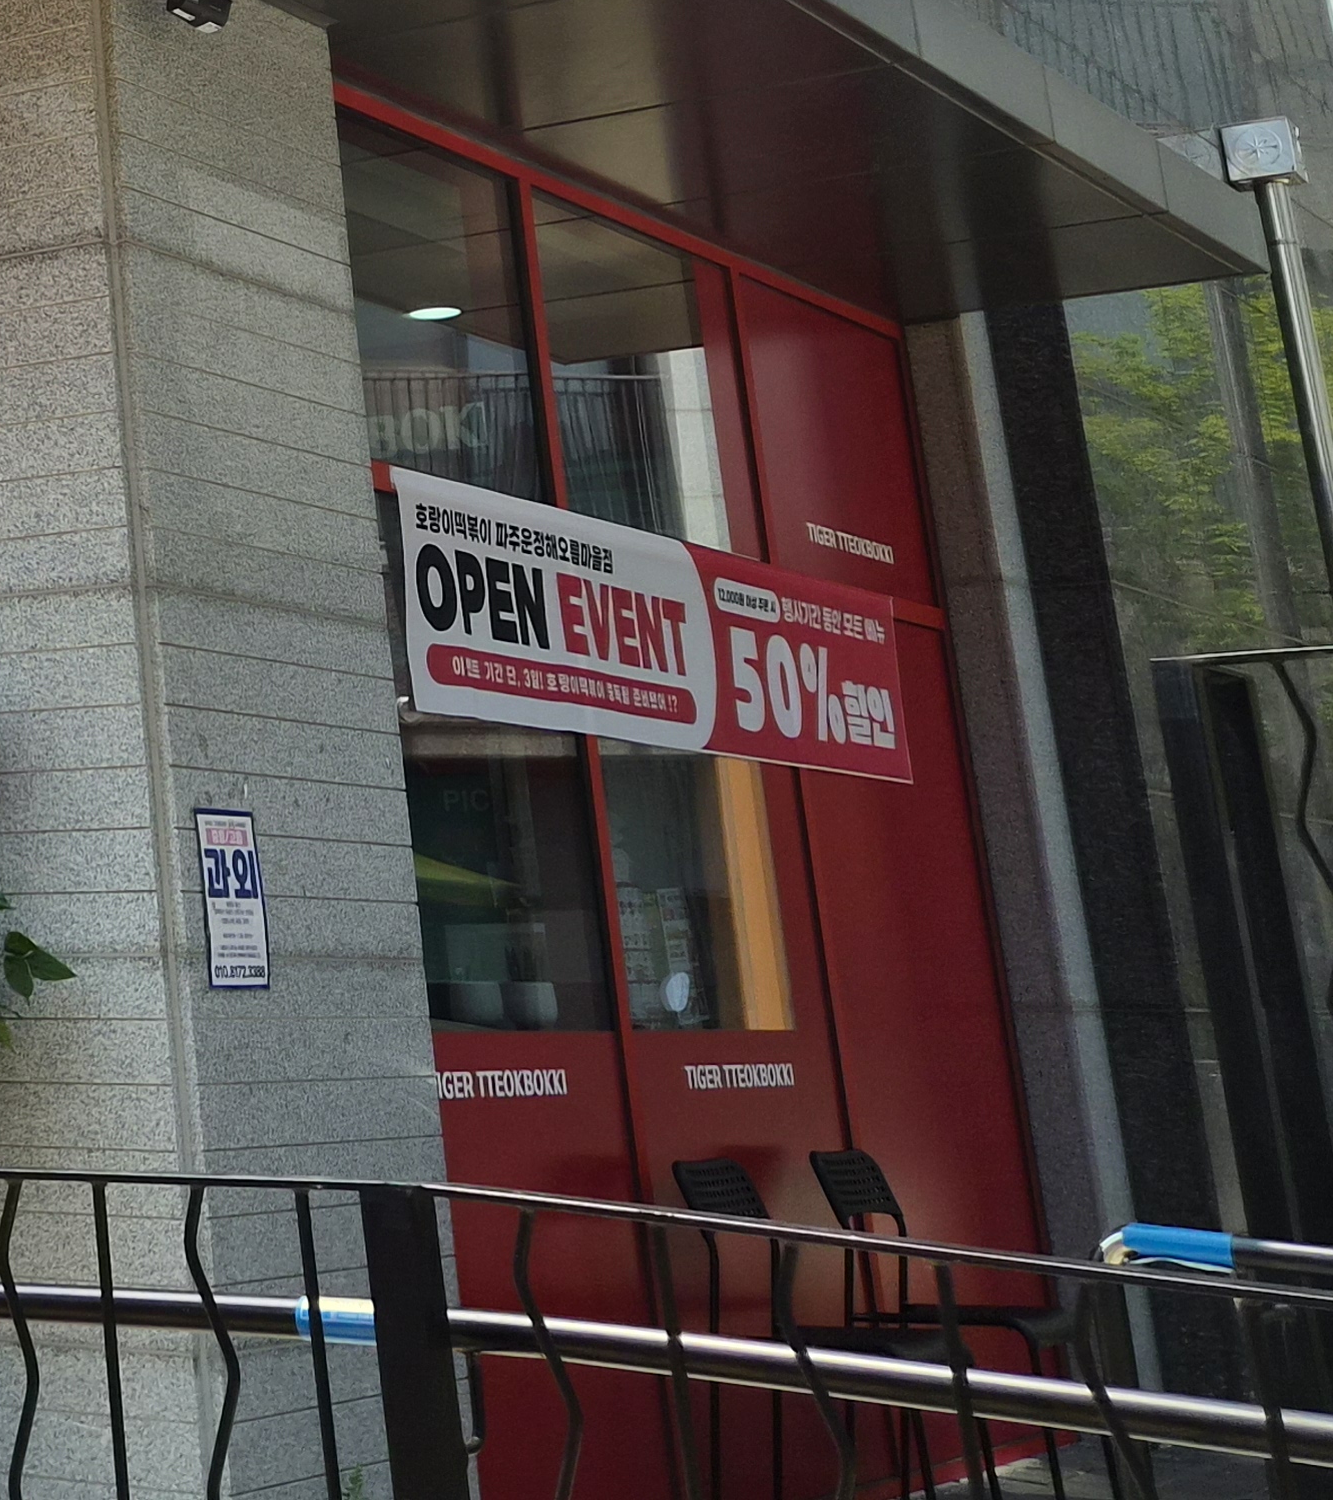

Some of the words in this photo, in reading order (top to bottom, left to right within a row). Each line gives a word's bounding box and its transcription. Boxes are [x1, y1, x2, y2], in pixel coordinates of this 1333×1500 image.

[415, 503, 491, 545] 호랑이떡볶이
[495, 522, 614, 575] 파주운정해오름마을점
[806, 521, 837, 549] TIGER
[416, 543, 550, 650] OPEN
[556, 572, 686, 677] EVENT
[484, 662, 504, 683] 기간
[204, 848, 259, 899] 과외
[436, 1071, 474, 1099] IGER
[476, 1069, 567, 1098] TTEOKBOKKI
[684, 1064, 722, 1089] TIGER
[722, 1063, 794, 1088] TTEOKBOKKI
